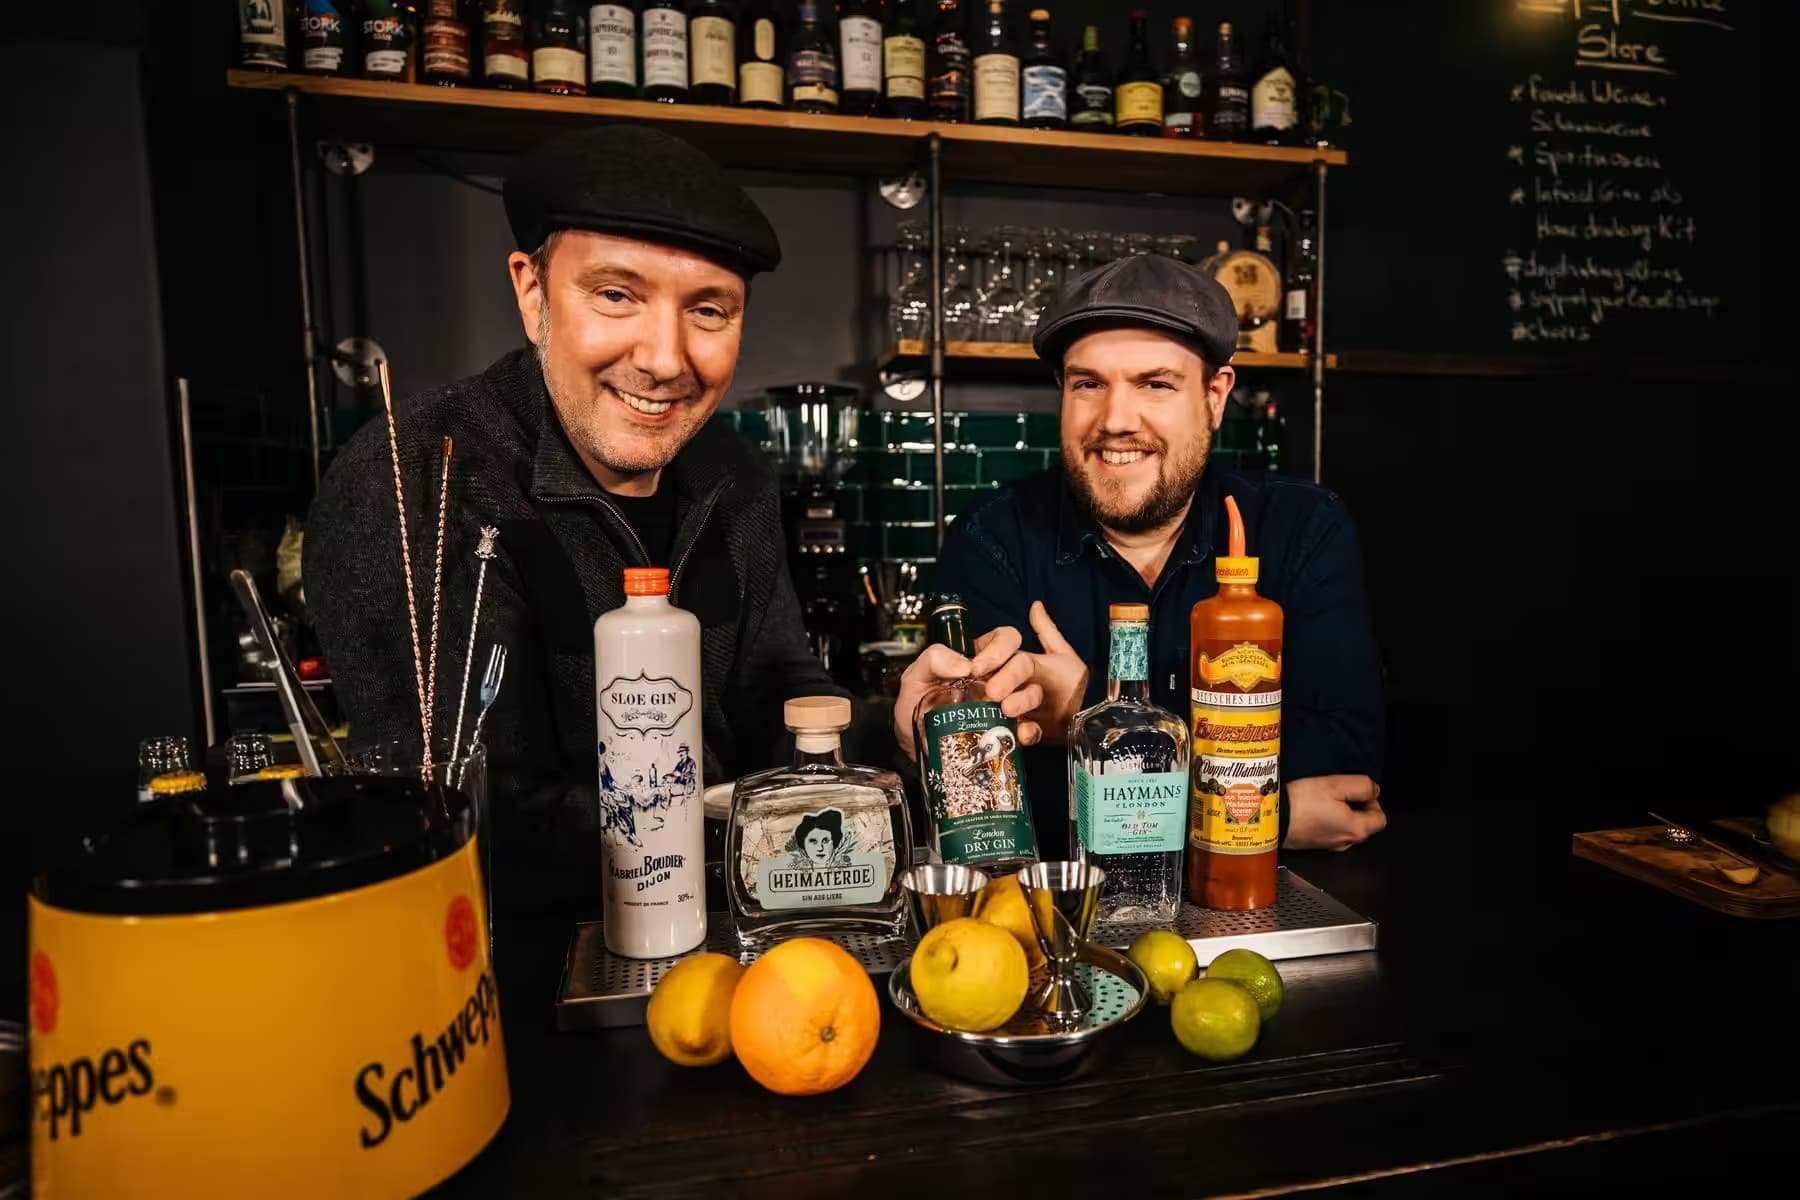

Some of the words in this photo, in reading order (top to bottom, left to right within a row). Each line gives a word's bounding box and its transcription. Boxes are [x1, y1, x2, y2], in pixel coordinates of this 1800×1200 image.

[1577, 23, 1665, 62] Store
[1658, 213, 1697, 245] Kit
[611, 692, 646, 706] SLOE
[650, 692, 677, 705] GIN
[958, 720, 988, 731] London
[1122, 801, 1166, 809] LONDON
[973, 828, 1005, 840] London
[964, 840, 991, 854] DRY
[993, 838, 1016, 849] GIN
[643, 854, 684, 877] BOUDIER
[637, 871, 671, 892] DIJON
[773, 869, 871, 888] HEIMATERDE
[802, 894, 813, 902] GIN
